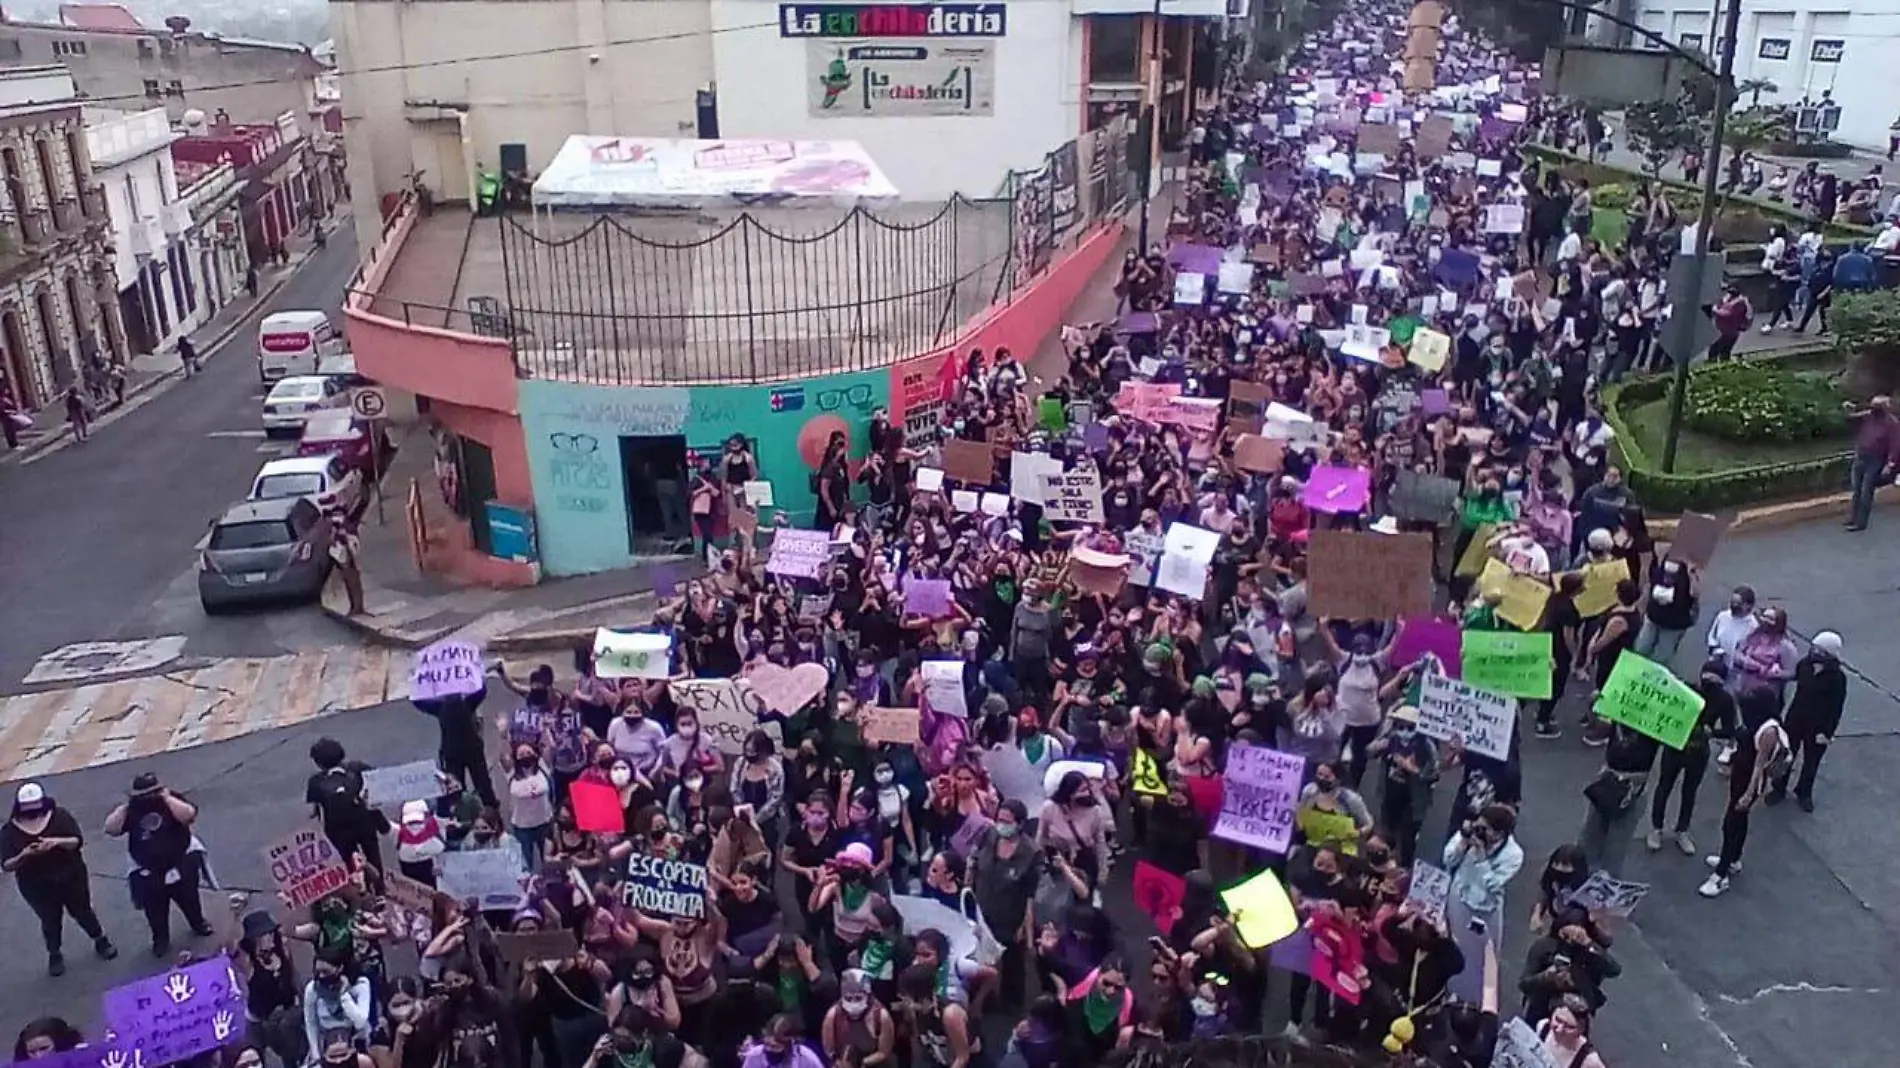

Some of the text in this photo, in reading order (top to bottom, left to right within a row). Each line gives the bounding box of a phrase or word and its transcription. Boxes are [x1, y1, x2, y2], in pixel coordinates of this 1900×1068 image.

[784, 4, 1001, 35] La enchiladería
[362, 395, 373, 413] E
[417, 665, 474, 685] MUJER
[674, 684, 757, 717] MÉXIC
[628, 852, 708, 890] ESCOPETA
